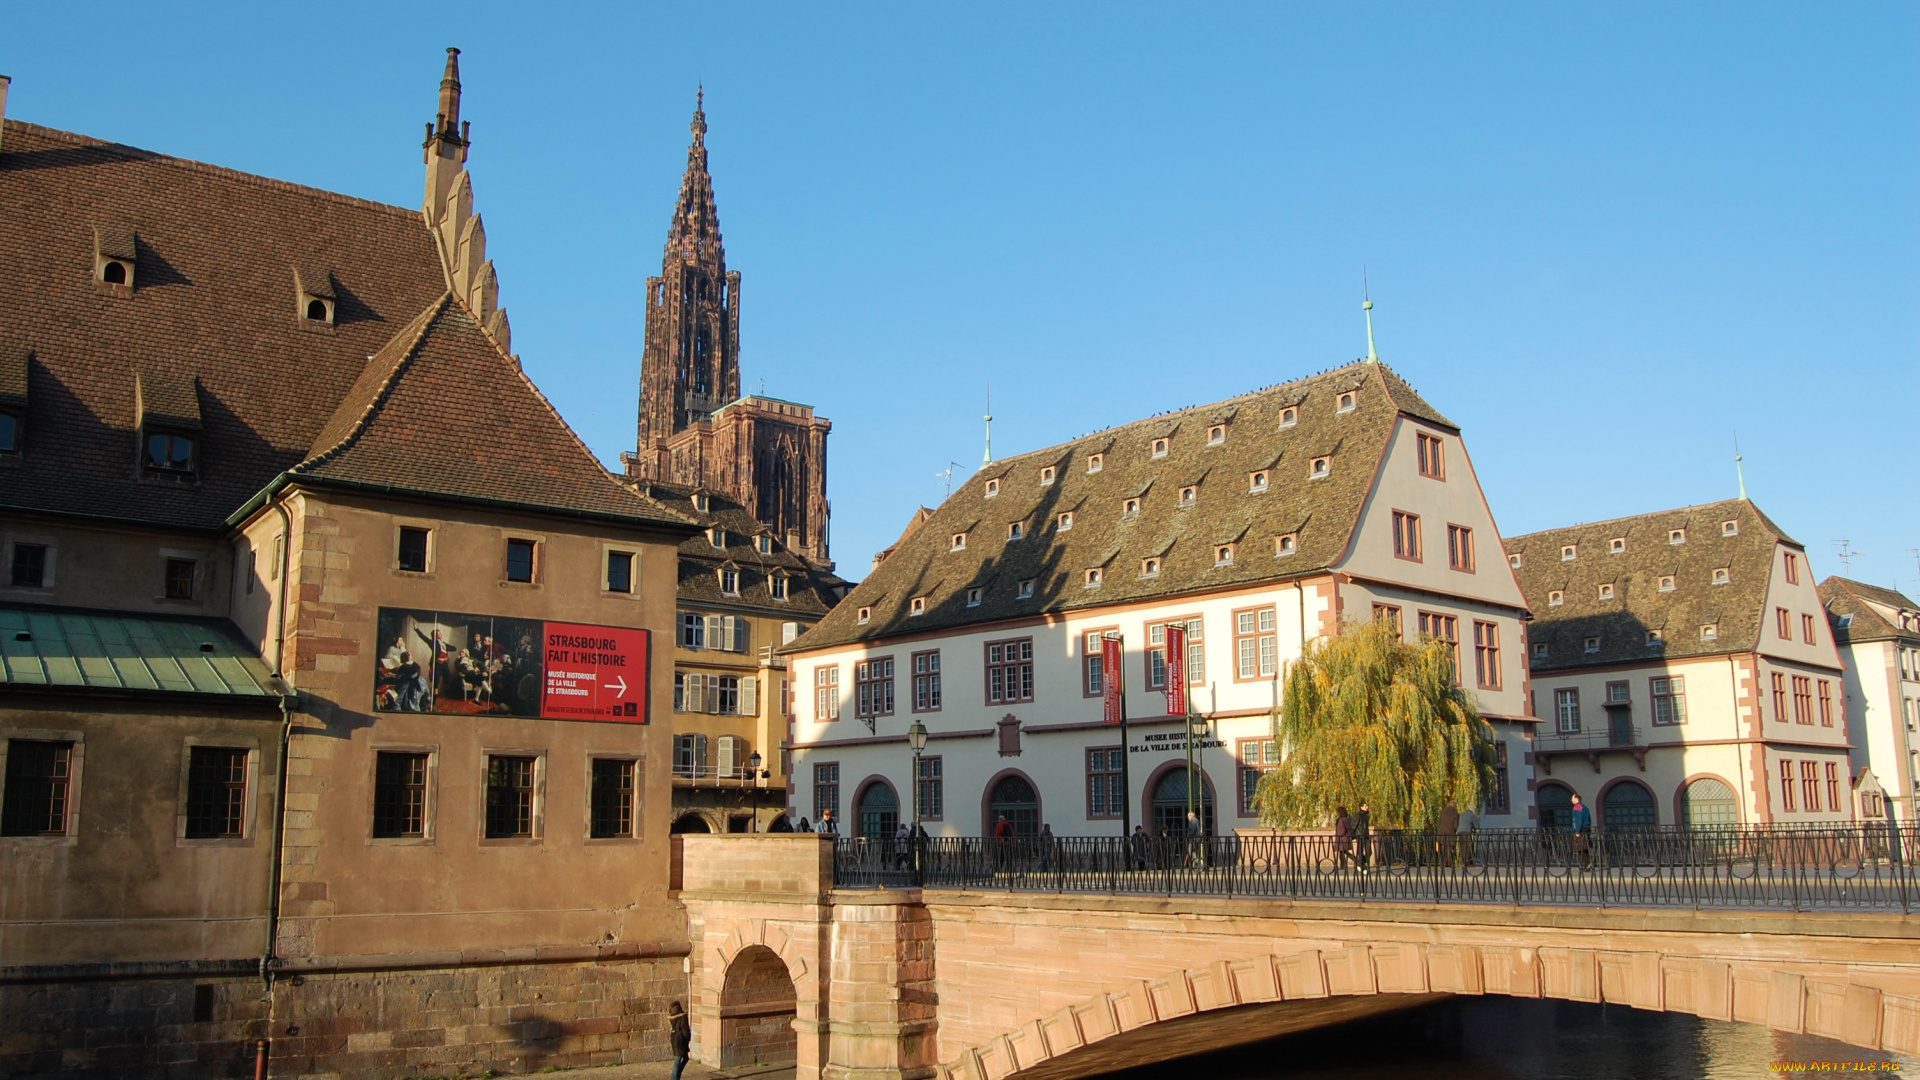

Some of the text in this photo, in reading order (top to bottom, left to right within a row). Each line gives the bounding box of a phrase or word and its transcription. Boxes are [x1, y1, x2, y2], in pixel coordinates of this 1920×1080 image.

[549, 634, 616, 651] STRASBOURG
[548, 650, 626, 666] FAIT L'HISTOIRE
[566, 672, 596, 680] HISTORIQUE
[556, 688, 588, 696] STRASBOURG
